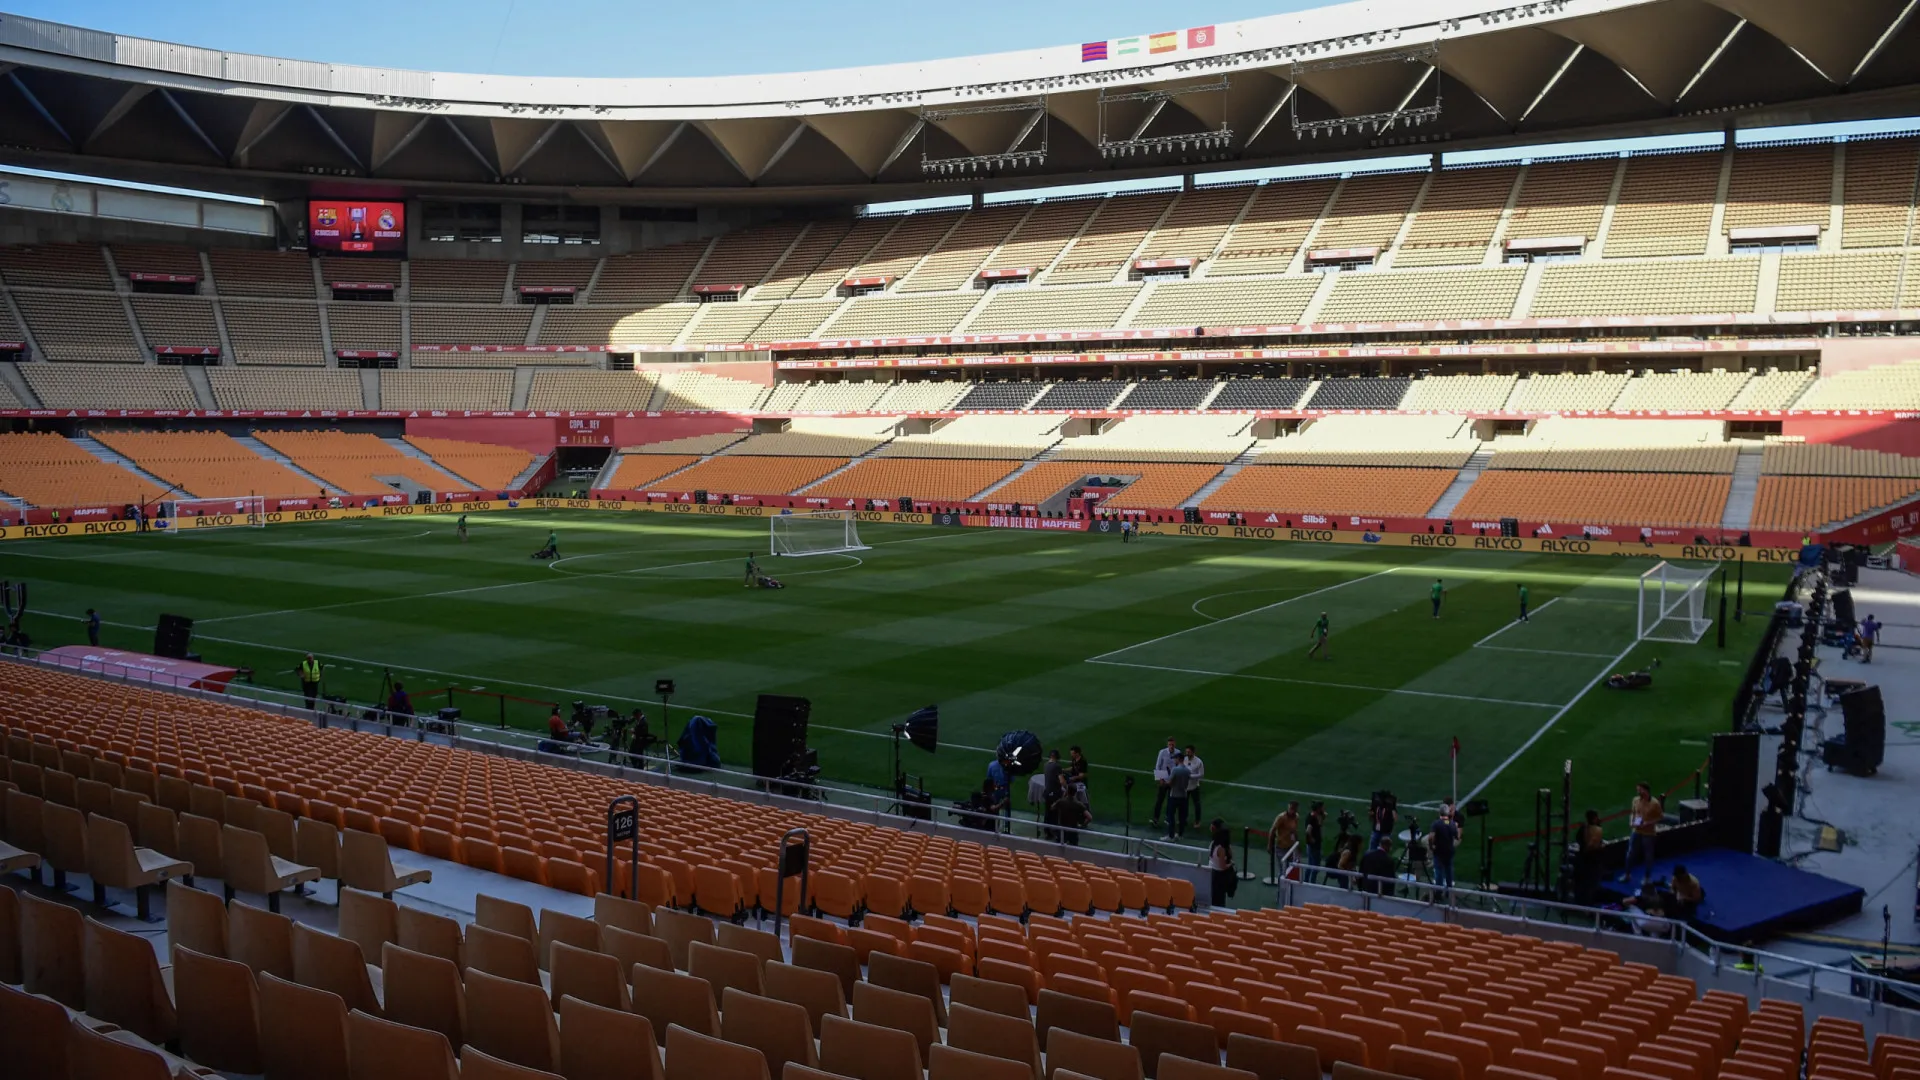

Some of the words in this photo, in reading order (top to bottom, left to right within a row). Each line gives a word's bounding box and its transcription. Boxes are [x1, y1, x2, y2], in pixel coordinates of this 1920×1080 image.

[463, 502, 490, 511] ALYCO
[536, 499, 559, 507] ALYCO
[567, 500, 590, 508] ALYCO
[598, 501, 622, 509] ALYCO
[74, 508, 108, 516] MAPFRE
[384, 506, 413, 515] ALYCO
[424, 504, 452, 513] ALYCO
[699, 505, 725, 514] ALYCO
[735, 507, 762, 516] ALYCO
[196, 515, 233, 525] ALYCO
[247, 512, 282, 523] ALYCO
[295, 510, 328, 520] ALYCO
[852, 511, 882, 521] ALYCO
[893, 513, 924, 523] ALYCO
[85, 521, 127, 533] ALYCO
[967, 517, 989, 527] FINAL
[989, 516, 1009, 528] COPA
[1010, 517, 1022, 528] DEL
[1024, 518, 1038, 528] REY
[1042, 520, 1081, 529] MAPFRE
[24, 524, 68, 537] ALYCO
[1180, 525, 1218, 536] ALYCO
[1234, 527, 1274, 538] ALYCO
[1290, 529, 1333, 541] ALYCO
[1411, 534, 1456, 547] ALYCO
[1475, 537, 1522, 549] ALYCO
[1541, 540, 1590, 552] ALYCO
[1682, 545, 1735, 559] ALYCO
[1757, 548, 1801, 562] ALYC
[615, 815, 632, 830] 126
